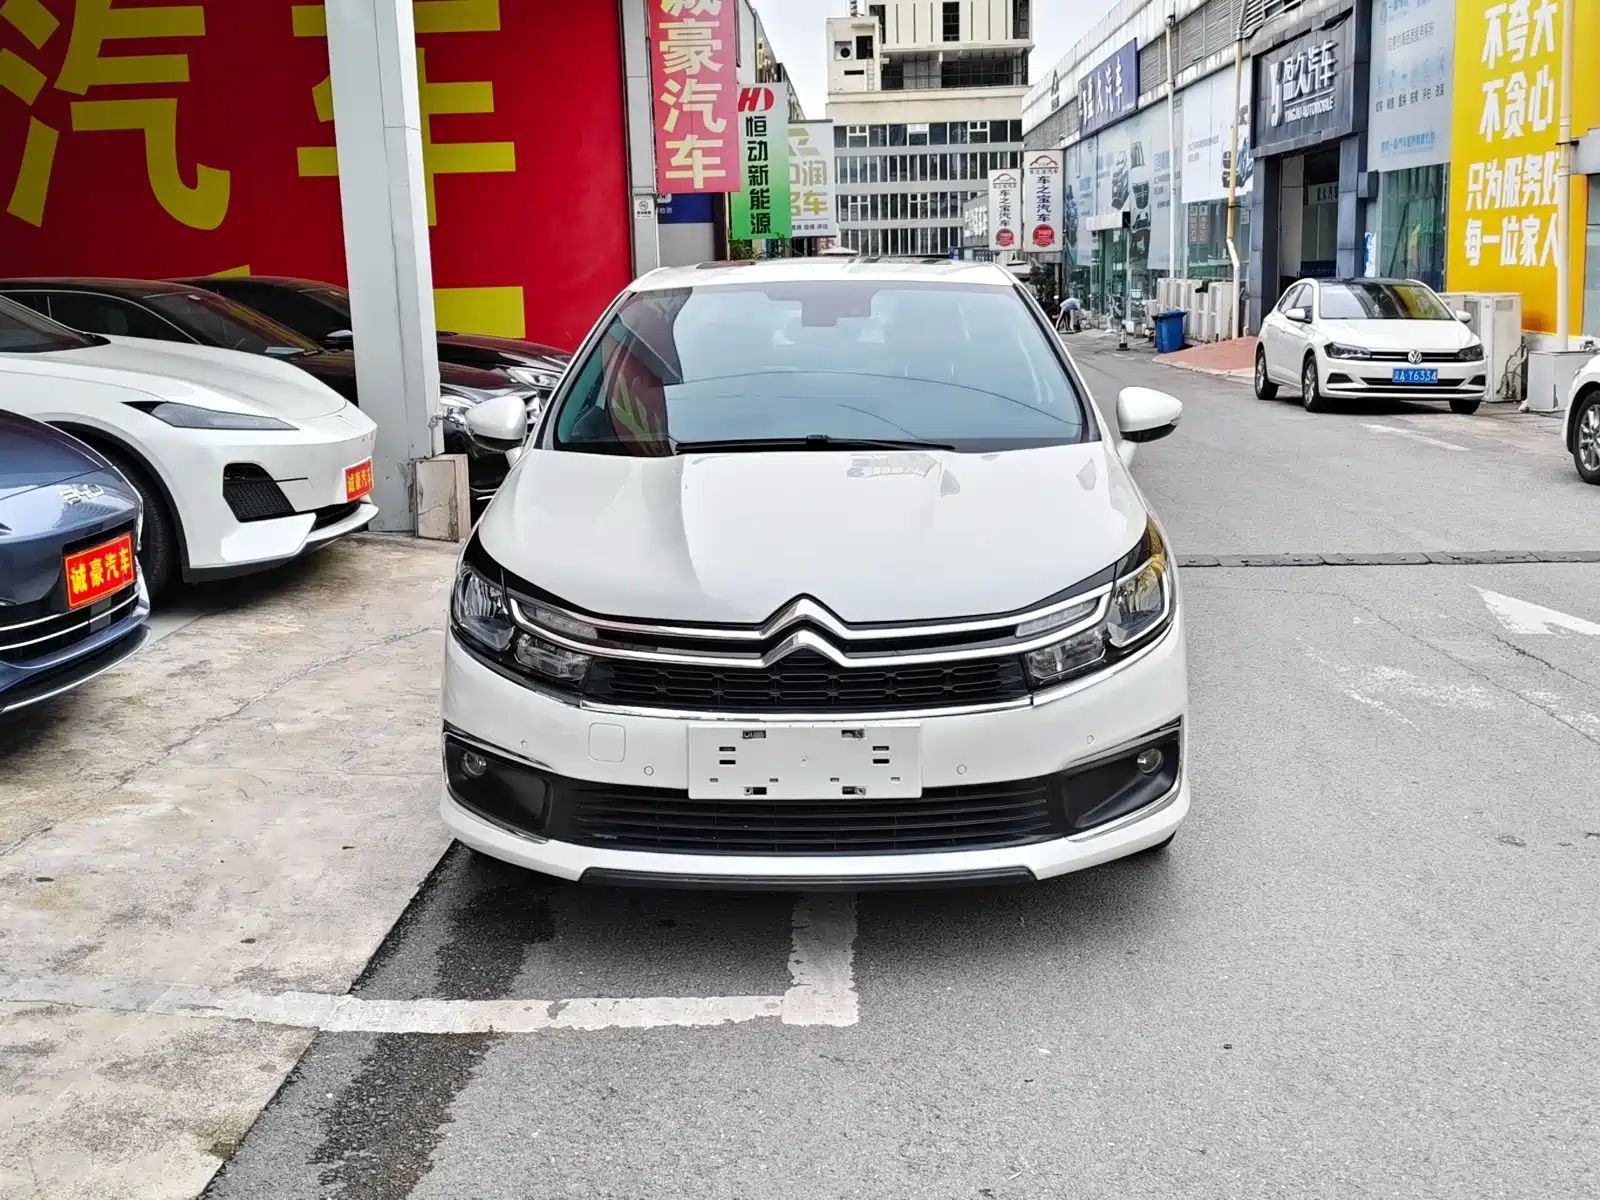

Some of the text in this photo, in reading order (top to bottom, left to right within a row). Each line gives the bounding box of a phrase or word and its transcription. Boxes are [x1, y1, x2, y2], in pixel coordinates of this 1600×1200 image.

[1481, 0, 1558, 69] 不夸大
[1479, 64, 1555, 142] 不贪心
[745, 115, 772, 234] 恒动新能源
[1036, 175, 1051, 222] 车之宝汽车
[1465, 151, 1559, 211] 只为服务好
[1464, 213, 1559, 267] 每一位家人
[347, 470, 373, 493] 诚豪汽车
[70, 545, 131, 594] 诚豪汽车
